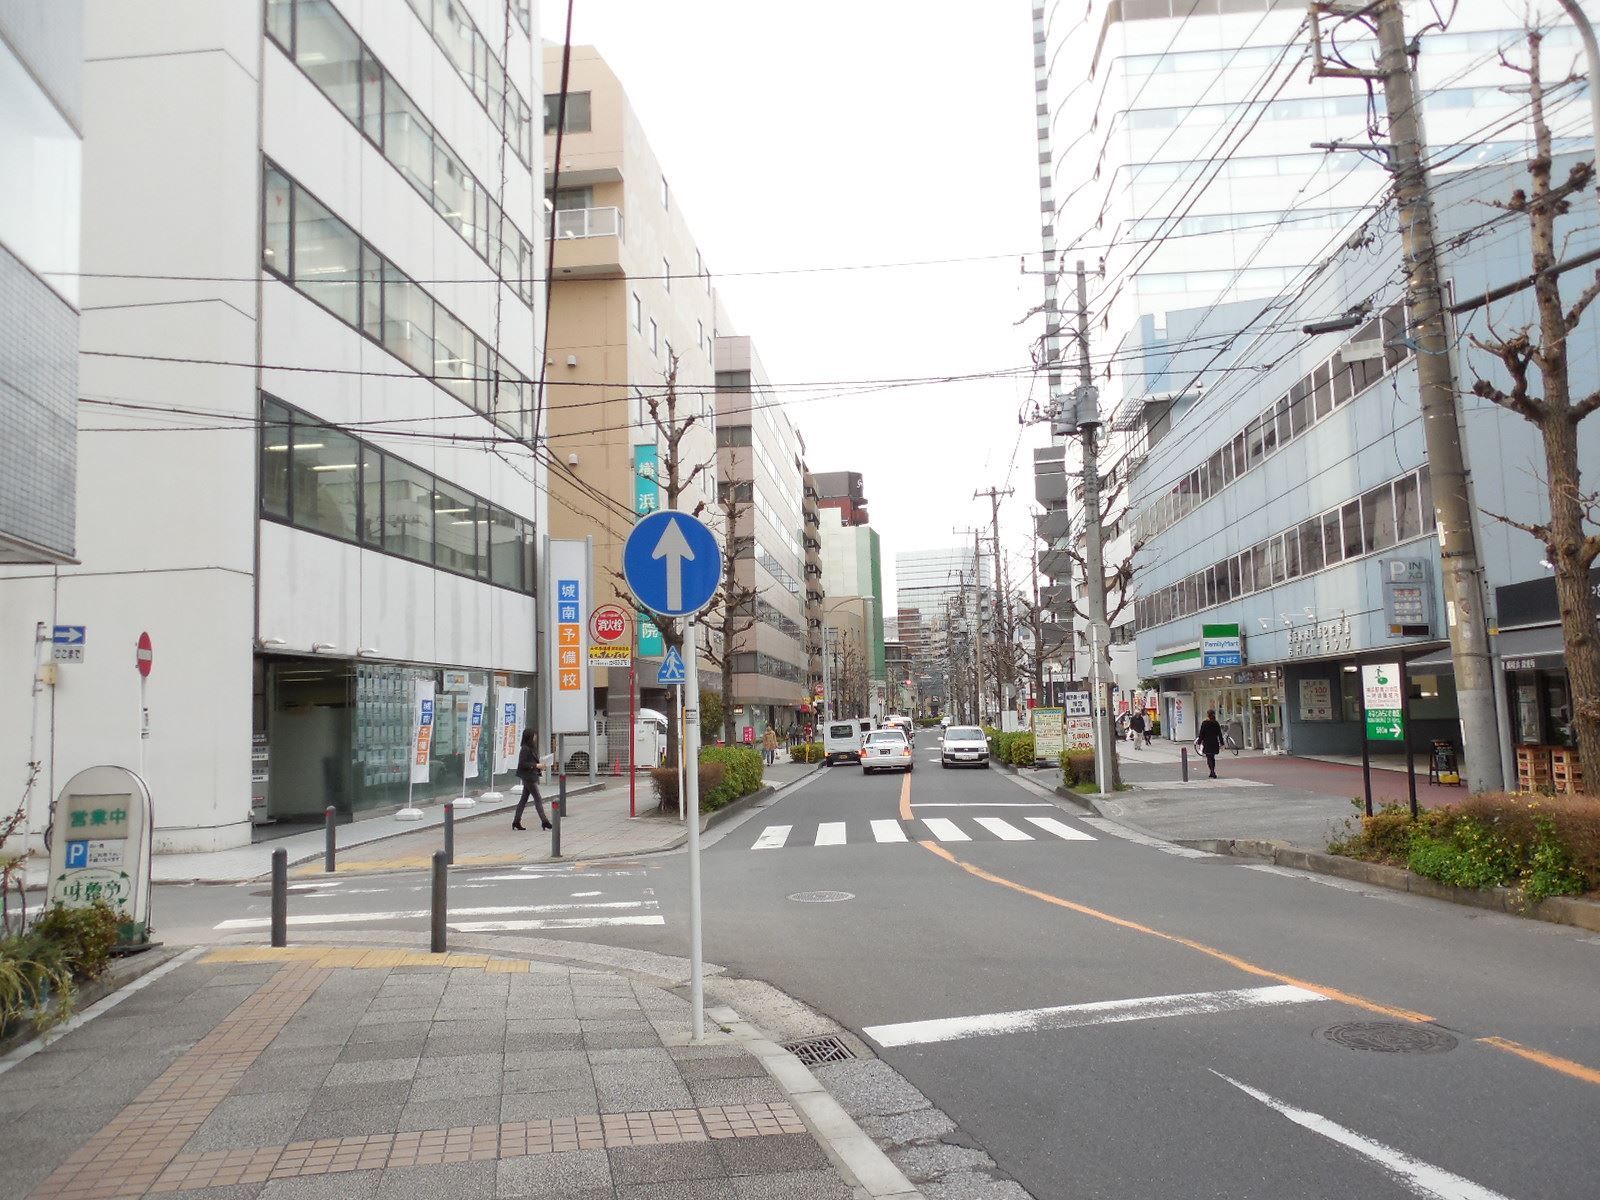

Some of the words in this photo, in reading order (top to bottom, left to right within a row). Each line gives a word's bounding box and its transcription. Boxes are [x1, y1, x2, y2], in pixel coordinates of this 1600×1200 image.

[1409, 562, 1421, 570] IN
[597, 619, 623, 632] 消火栓
[642, 622, 659, 638] 院
[561, 583, 577, 688] 城南予備校
[1204, 640, 1240, 648] FamilyMart
[55, 649, 81, 659] ここまで
[1220, 656, 1239, 664] たばこ
[70, 808, 126, 828] 営業中
[70, 844, 84, 864] P
